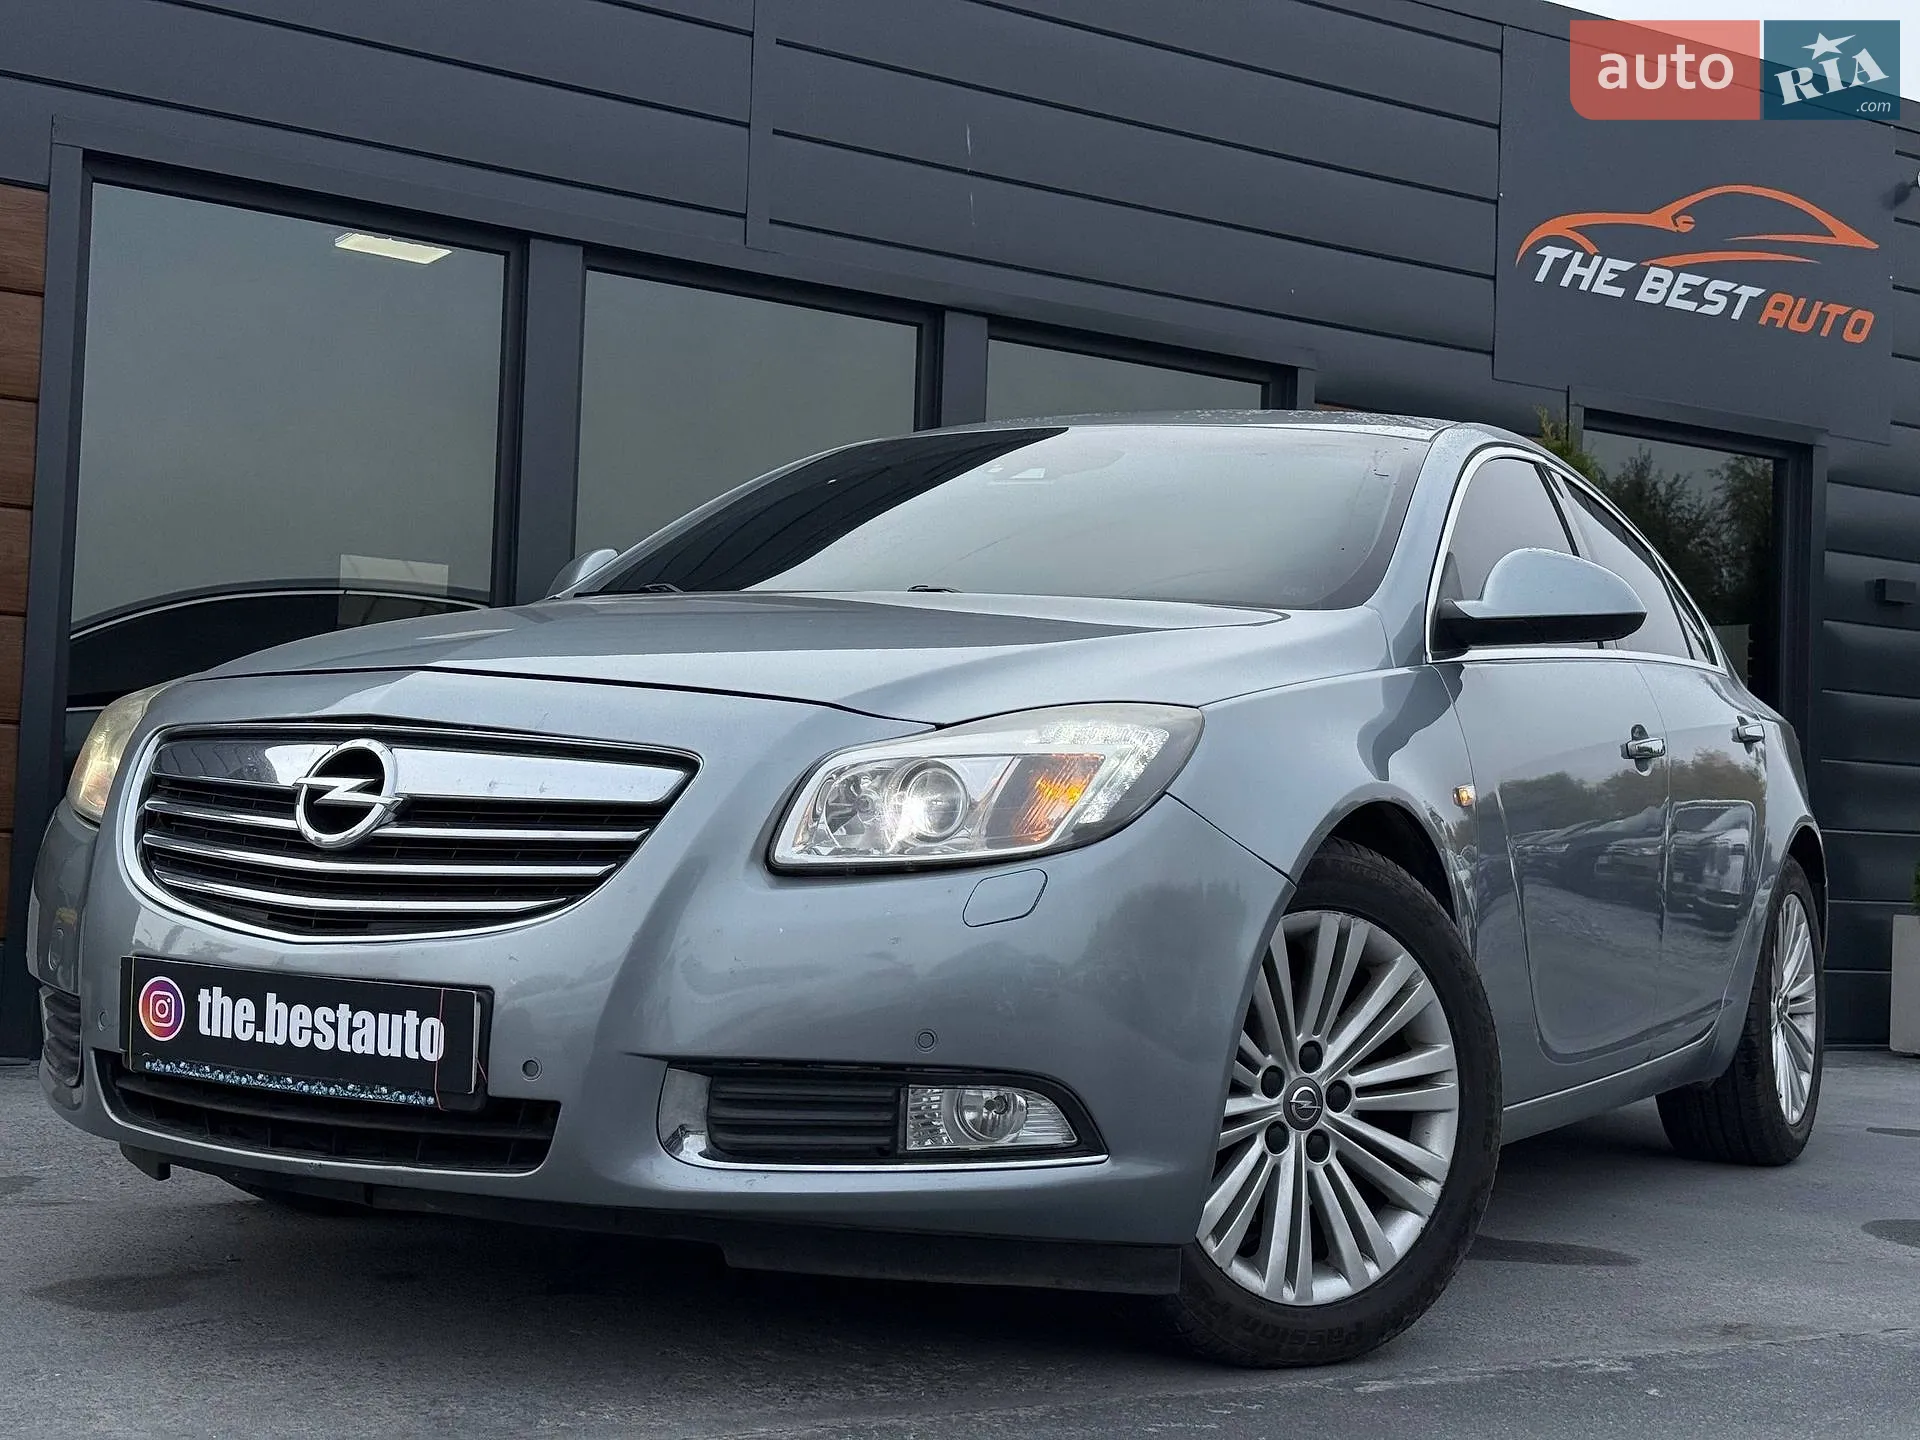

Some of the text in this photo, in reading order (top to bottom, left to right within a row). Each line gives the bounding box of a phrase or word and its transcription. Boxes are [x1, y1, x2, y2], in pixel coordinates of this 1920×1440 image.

[1535, 245, 1875, 344] THE BEST AUTO
[198, 986, 445, 1062] the.bestauto
